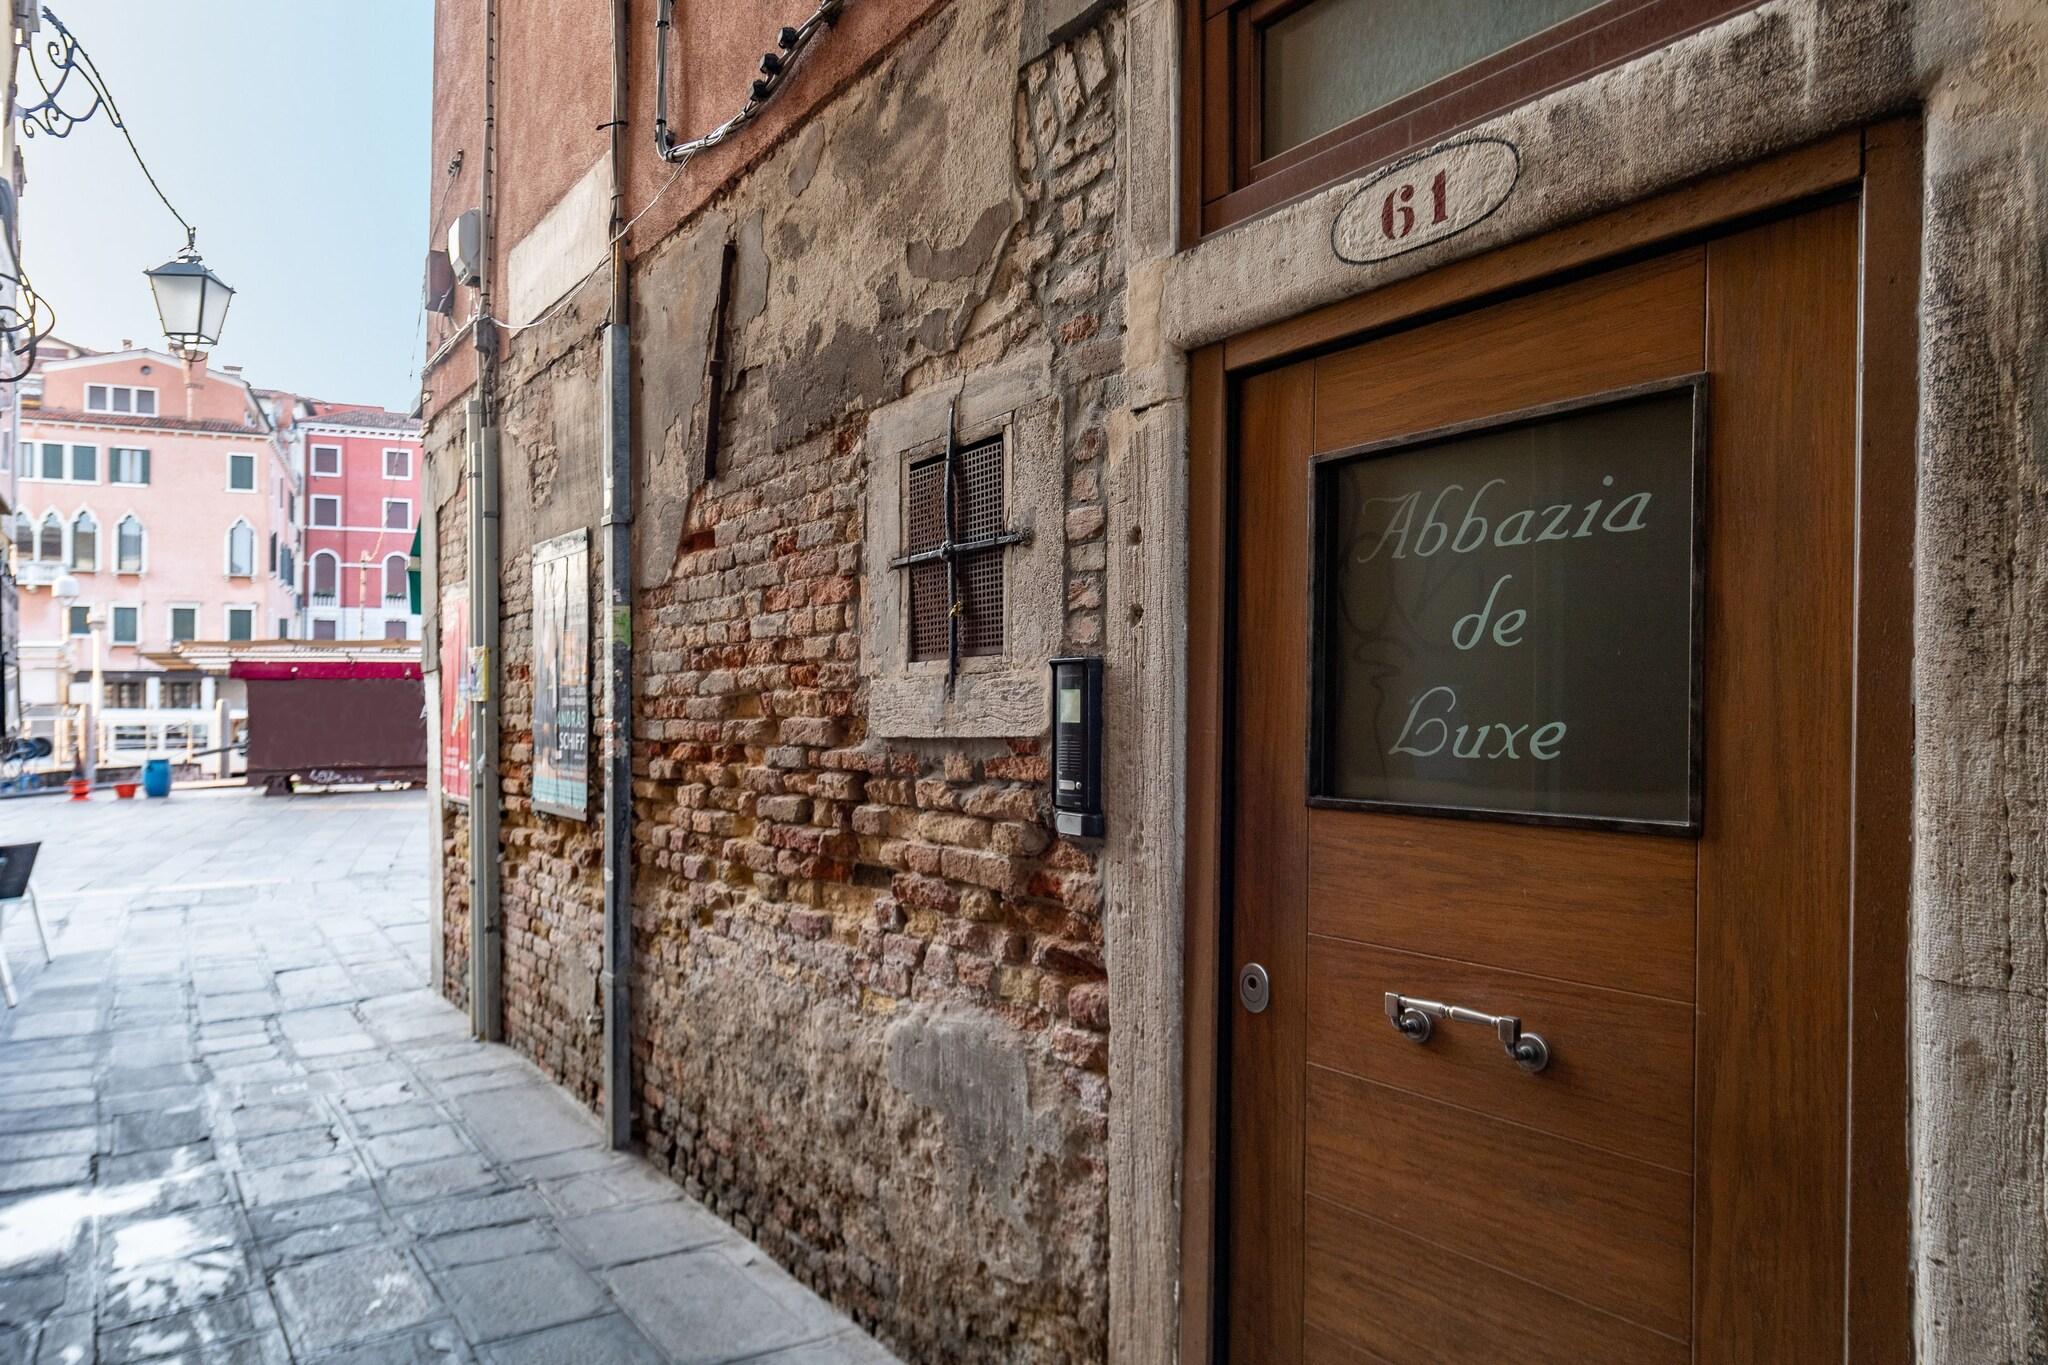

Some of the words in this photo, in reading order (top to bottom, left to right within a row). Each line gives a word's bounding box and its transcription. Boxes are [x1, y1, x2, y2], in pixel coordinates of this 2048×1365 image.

[1380, 168, 1448, 240] 61
[1357, 475, 1652, 563] Abbazia
[1451, 574, 1527, 650] de
[559, 731, 586, 751] SCHIFF
[1388, 686, 1567, 760] Luxe
